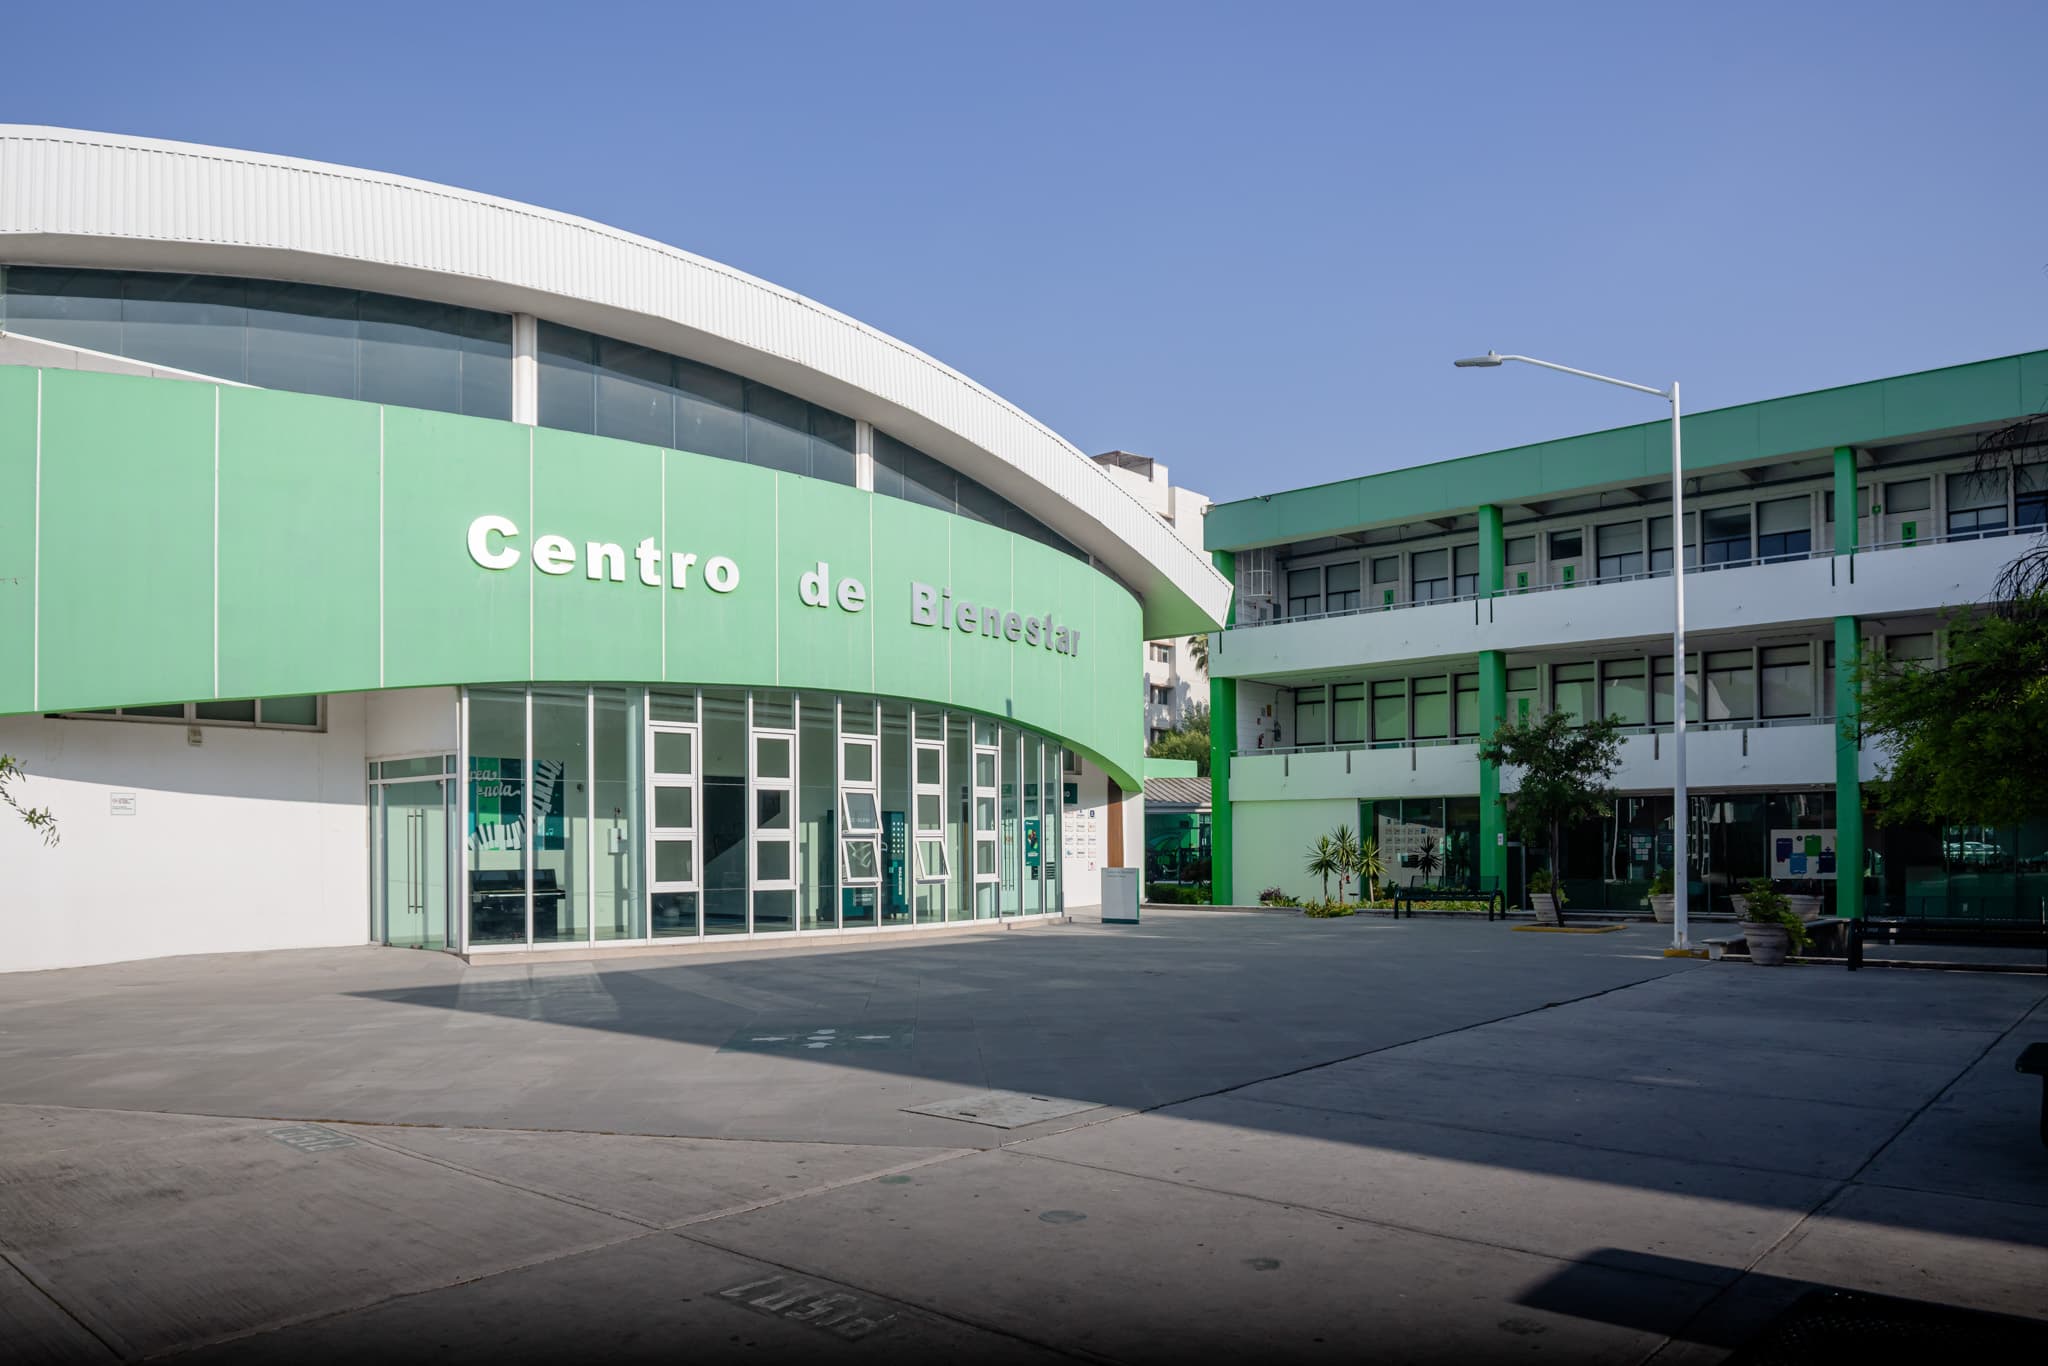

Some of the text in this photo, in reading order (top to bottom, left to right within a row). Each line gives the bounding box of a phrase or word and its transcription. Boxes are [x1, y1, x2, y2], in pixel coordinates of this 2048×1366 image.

[466, 514, 1082, 658] Centro de Bienestar
